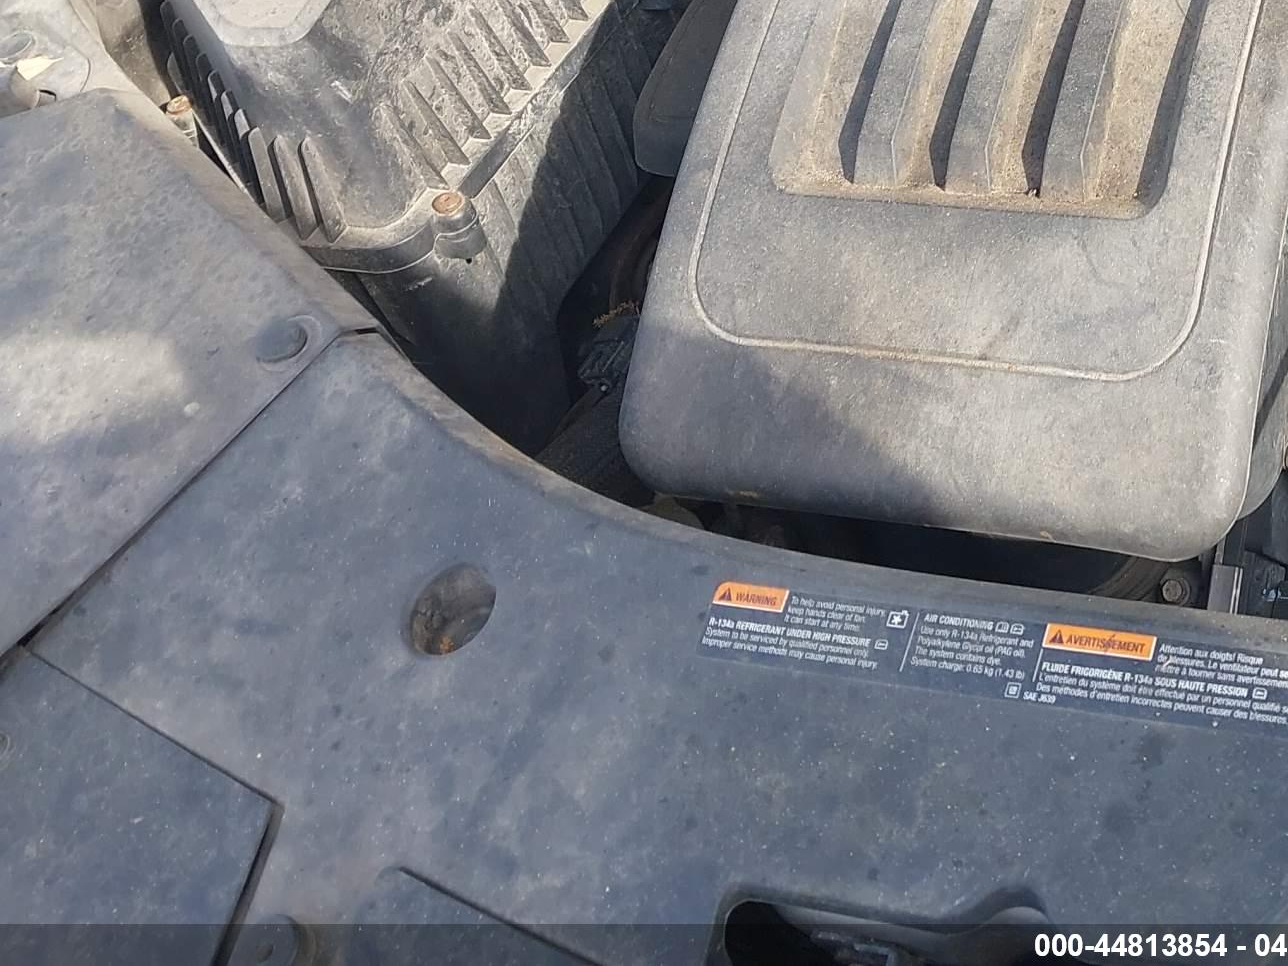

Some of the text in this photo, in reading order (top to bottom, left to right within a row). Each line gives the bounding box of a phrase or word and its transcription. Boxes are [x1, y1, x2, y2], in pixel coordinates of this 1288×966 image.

[735, 591, 776, 606] WARNING
[800, 598, 814, 607] help
[816, 600, 834, 608] avoid
[834, 602, 864, 613] personal
[788, 606, 804, 615] keep
[804, 608, 826, 617] hands
[826, 611, 844, 619] clear
[924, 613, 994, 630] AIR CONDITIONING
[708, 617, 870, 646] R-134a REFRIGERANT UNDER HIGH PRESSURE
[790, 616, 803, 624] can
[804, 618, 820, 626] start
[829, 621, 842, 630] any
[705, 628, 730, 638] System
[731, 631, 738, 639] to
[739, 632, 749, 640] be
[750, 634, 778, 644] serviced
[778, 637, 788, 646] by
[788, 639, 817, 650] qualified
[818, 643, 852, 654] personnel
[920, 625, 1034, 647] Use only R-134a Refrigerant and
[701, 638, 732, 649] Improper
[732, 642, 758, 651] service
[758, 645, 788, 655] methods
[788, 649, 804, 658] may
[804, 651, 826, 660] cause
[826, 654, 856, 665] personal
[914, 646, 928, 655] The
[928, 648, 954, 659] system
[954, 651, 986, 662] contains
[984, 644, 994, 653] oil
[994, 646, 1012, 656] (PAG
[1158, 644, 1192, 655] Attention
[1193, 649, 1208, 657] aux
[1236, 654, 1263, 665] Risque
[910, 657, 936, 668] System
[984, 666, 994, 676] kg
[1157, 654, 1167, 662] de
[1219, 662, 1260, 674] ventilateur
[1260, 668, 1278, 677] peut
[1278, 670, 1288, 678] se
[1188, 668, 1216, 678] tourner
[1216, 672, 1235, 680] sans
[1041, 661, 1248, 697] FLUIDE FRIGORIGÈNE R-134a SOUS HAUTE PRESSION
[1022, 692, 1037, 700] SAE
[1036, 682, 1050, 691] Des
[1051, 685, 1088, 696] méthodes
[1088, 689, 1129, 702] d'entretien
[1130, 695, 1172, 707] incorrectes
[1172, 701, 1205, 713] peuvent
[1205, 705, 1232, 715] causer
[1232, 708, 1248, 717] des
[1038, 672, 1077, 684] L'entretien
[1089, 679, 1120, 691] système
[1121, 683, 1136, 692] doit
[1186, 692, 1200, 701] par
[1200, 694, 1212, 702] un
[1212, 695, 1251, 708] personnel
